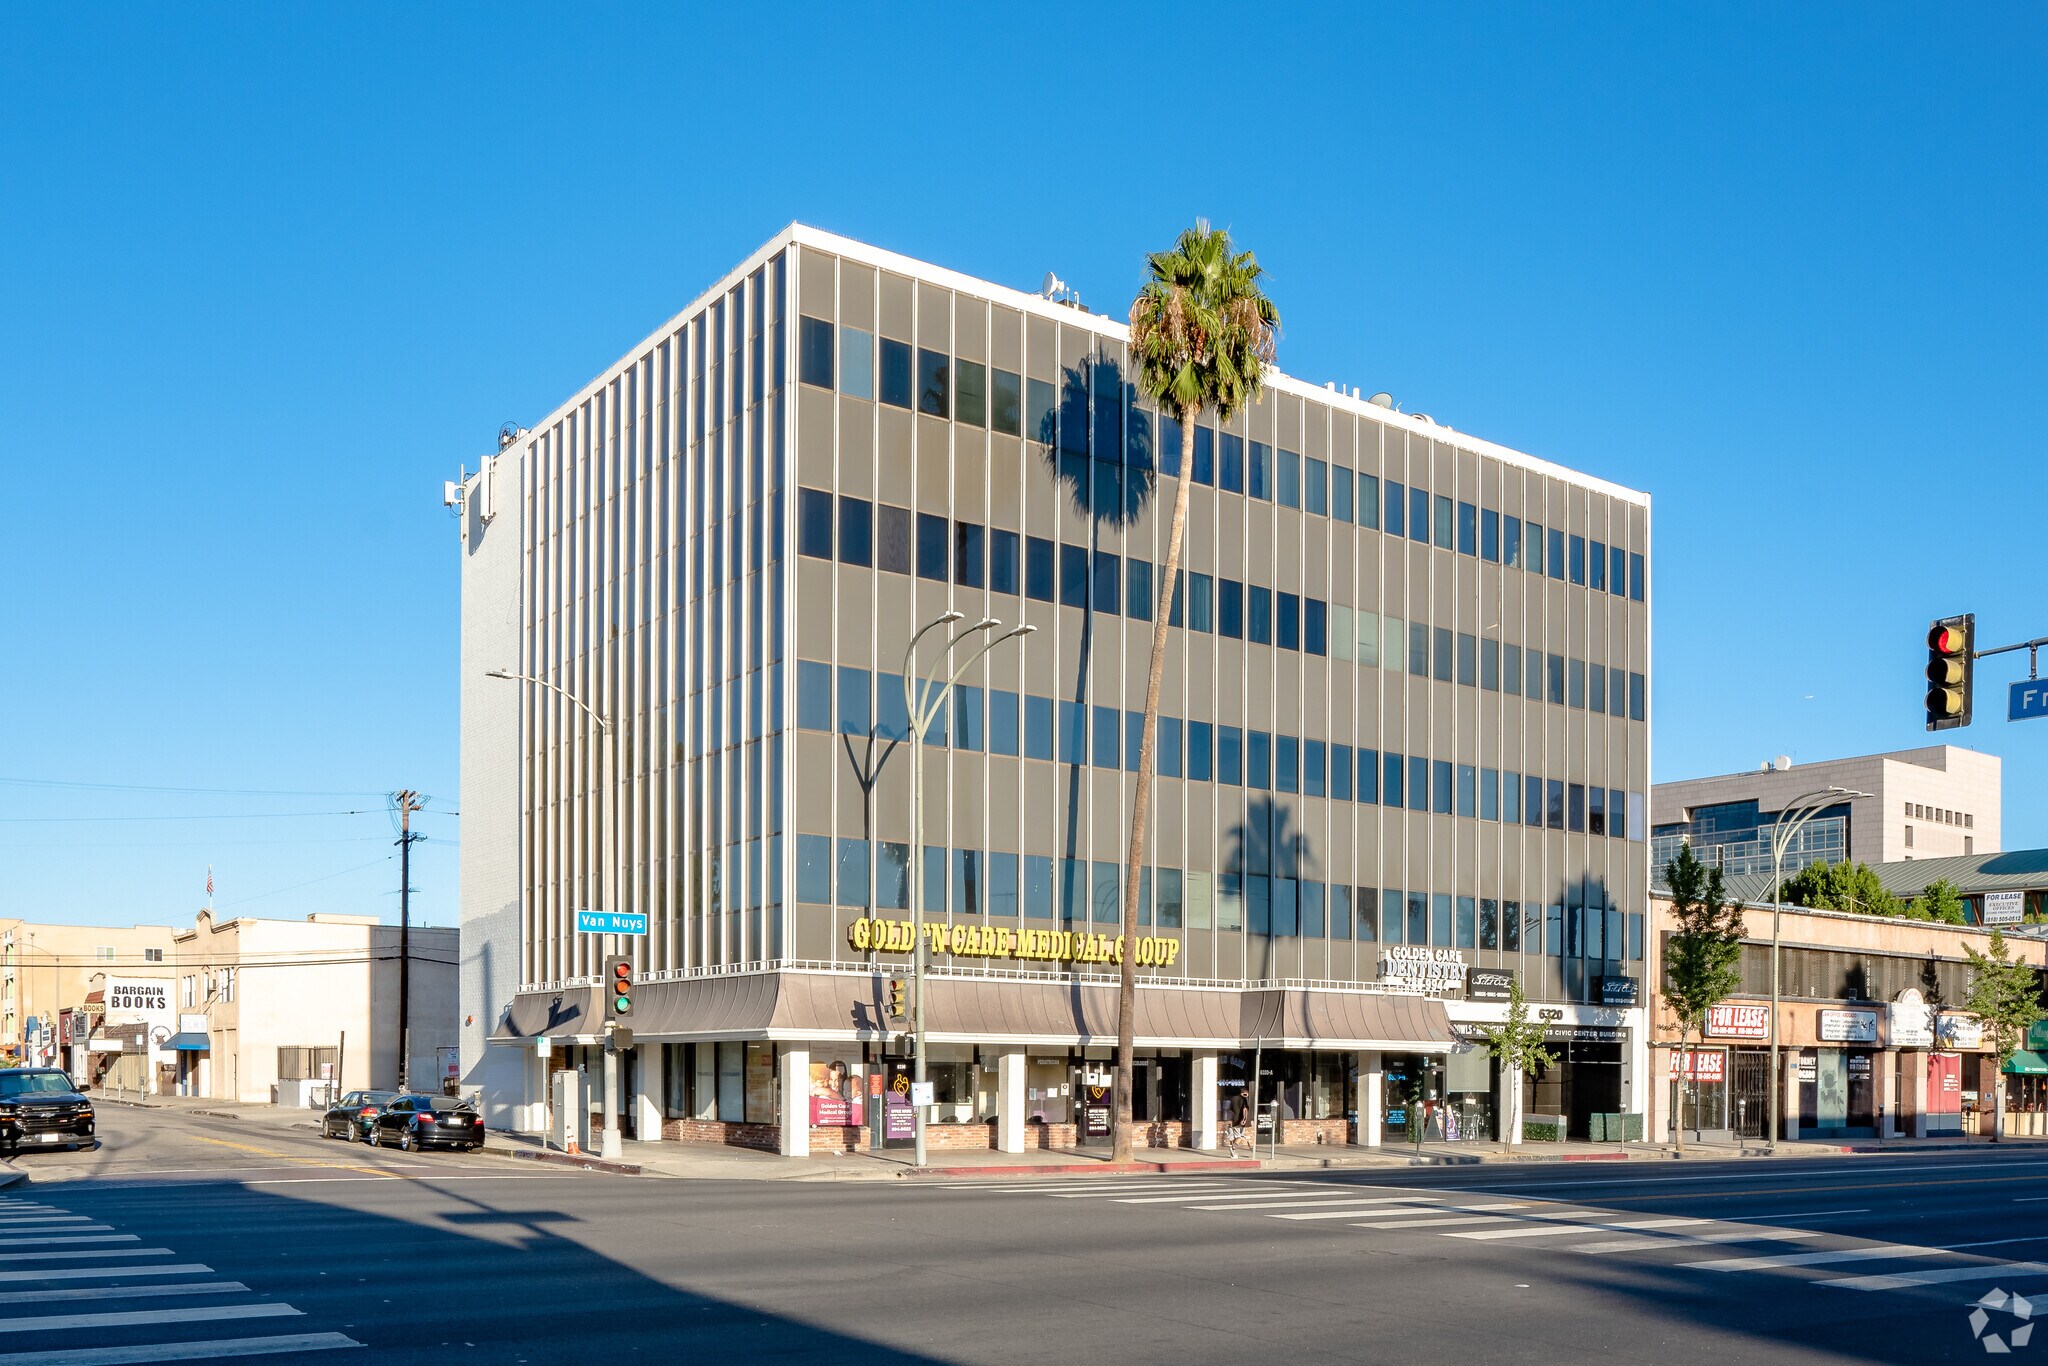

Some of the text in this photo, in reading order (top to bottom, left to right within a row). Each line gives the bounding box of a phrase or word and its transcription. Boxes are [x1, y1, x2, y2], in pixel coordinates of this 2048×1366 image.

[582, 914, 643, 931] Van Nuys
[951, 924, 1009, 956] CARE
[1015, 928, 1110, 962] MEDICAL
[1393, 946, 1463, 964] GOLDEN CARE
[1386, 959, 1469, 980] DENTISTRY
[113, 985, 164, 996] BARGAIN
[83, 1004, 104, 1013] BOOKS
[111, 995, 166, 1010] BOOKS
[1538, 1008, 1563, 1021] 6320
[1712, 1007, 1764, 1028] FOR LEASE
[1573, 1030, 1598, 1038] CENTER
[1697, 1053, 1723, 1073] EASE
